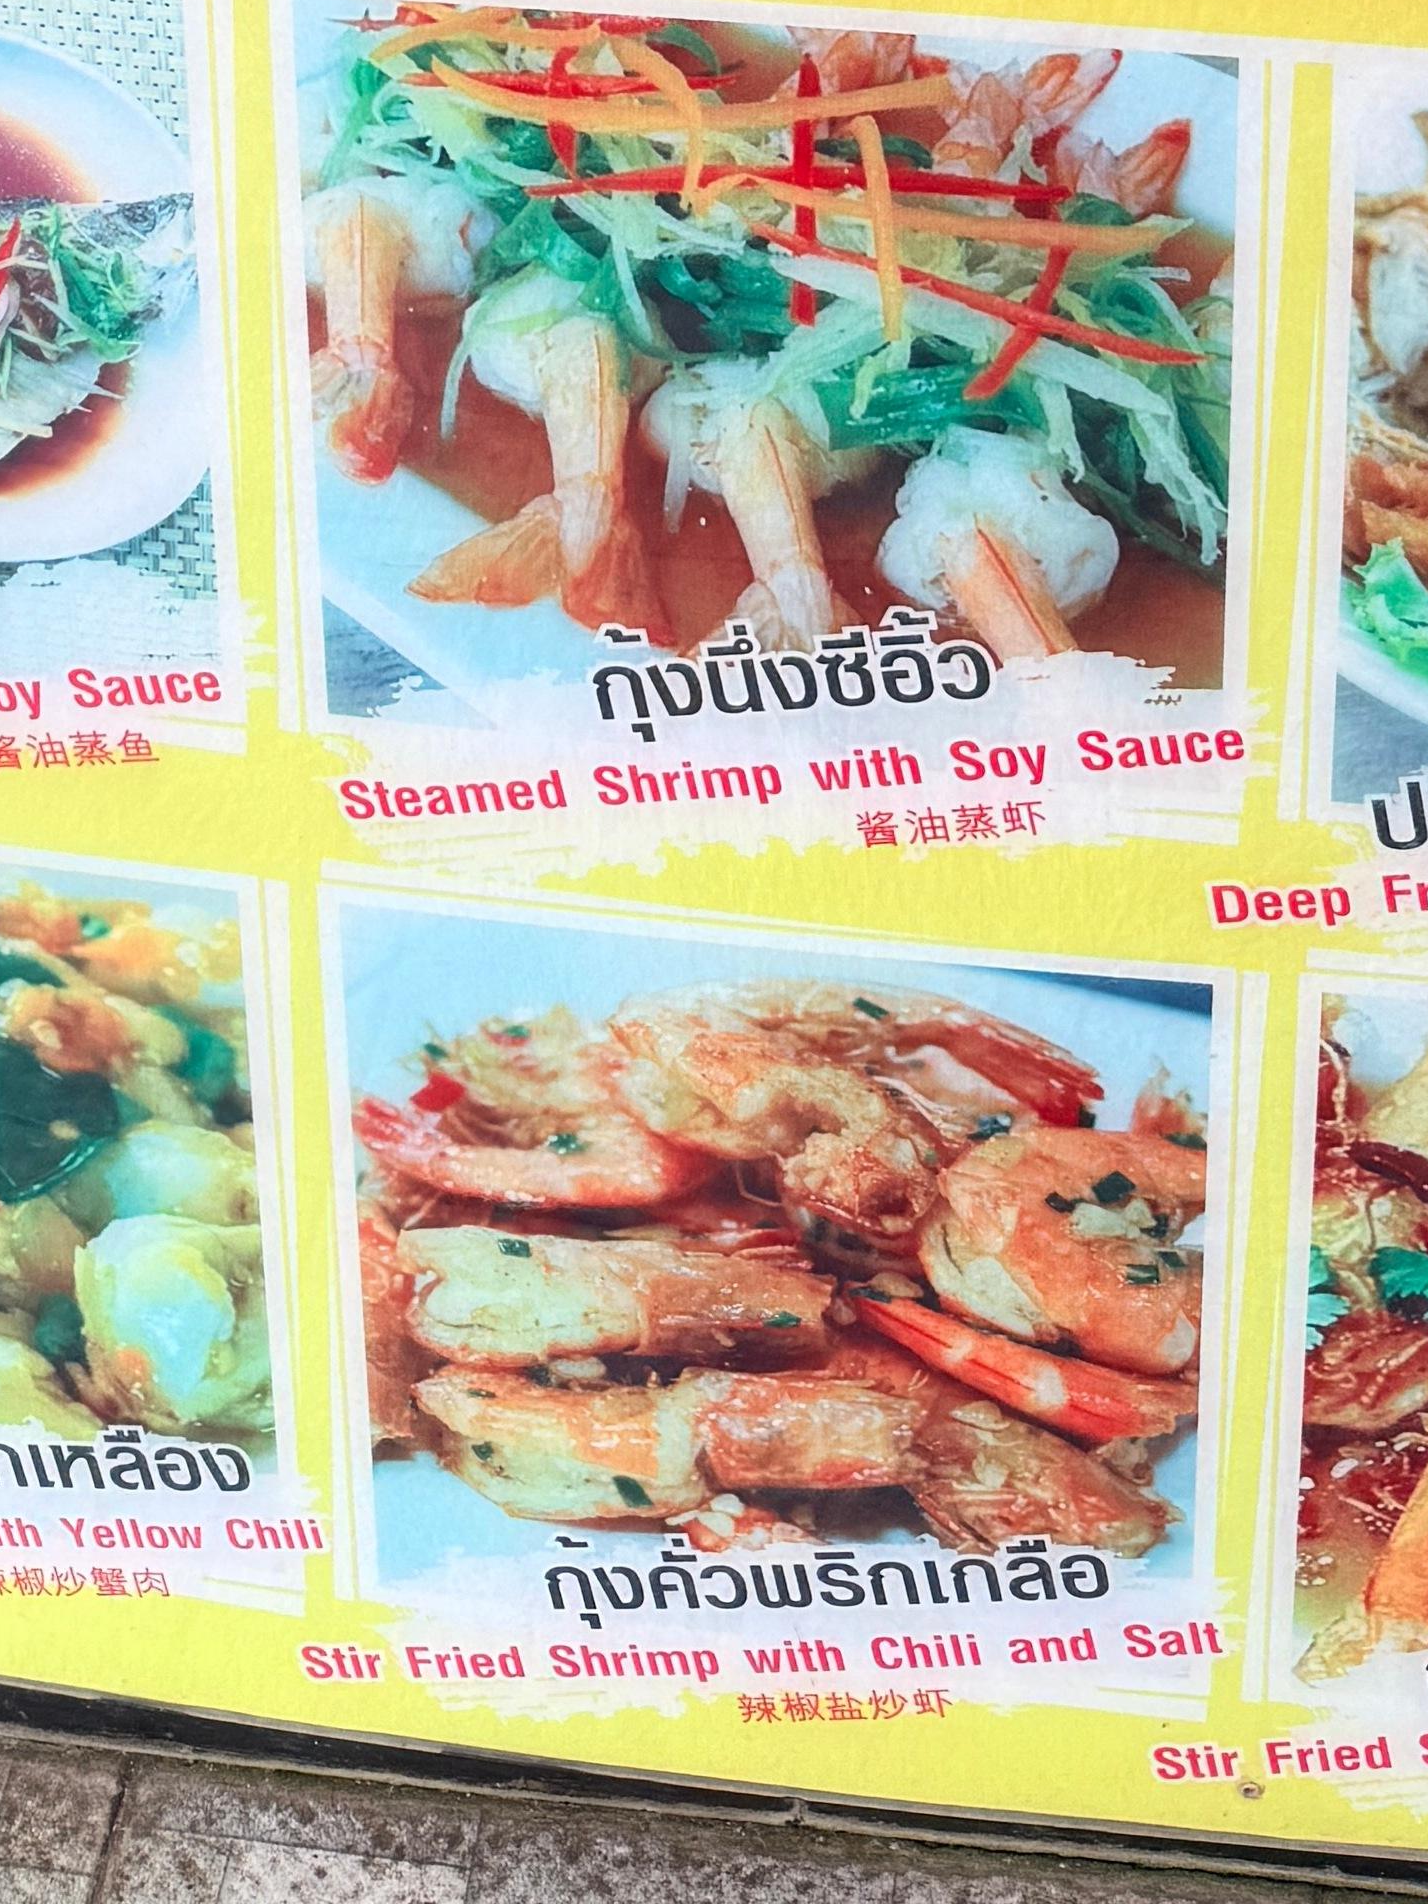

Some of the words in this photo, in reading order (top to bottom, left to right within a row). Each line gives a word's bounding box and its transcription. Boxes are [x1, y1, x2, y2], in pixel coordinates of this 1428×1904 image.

[68, 668, 220, 708] Sauce
[593, 601, 994, 742] กุ้งนึ่งซีอิ้ว
[340, 770, 566, 819] Steamed
[593, 762, 781, 805] Shrimp
[809, 747, 921, 791] with
[949, 740, 1046, 785] Soy
[1077, 730, 1244, 771] Sauce
[856, 800, 1045, 848] 酱油蒸虾
[1211, 886, 1351, 926] Deep
[60, 1516, 203, 1551] Yellow
[224, 1516, 324, 1552] Chili
[546, 1533, 1108, 1629] กุ้งคั่วพริกเกลือ
[302, 1647, 379, 1678] Stir
[406, 1647, 524, 1678] Fried
[549, 1646, 719, 1682] Shrimp
[746, 1641, 844, 1673] with
[871, 1636, 980, 1669] Chili
[1011, 1629, 1096, 1663] and
[1124, 1623, 1221, 1658] Salt
[737, 1686, 953, 1726] 辣椒盐炒虾
[1153, 1746, 1235, 1780] Stir
[1266, 1736, 1392, 1774] Fried
